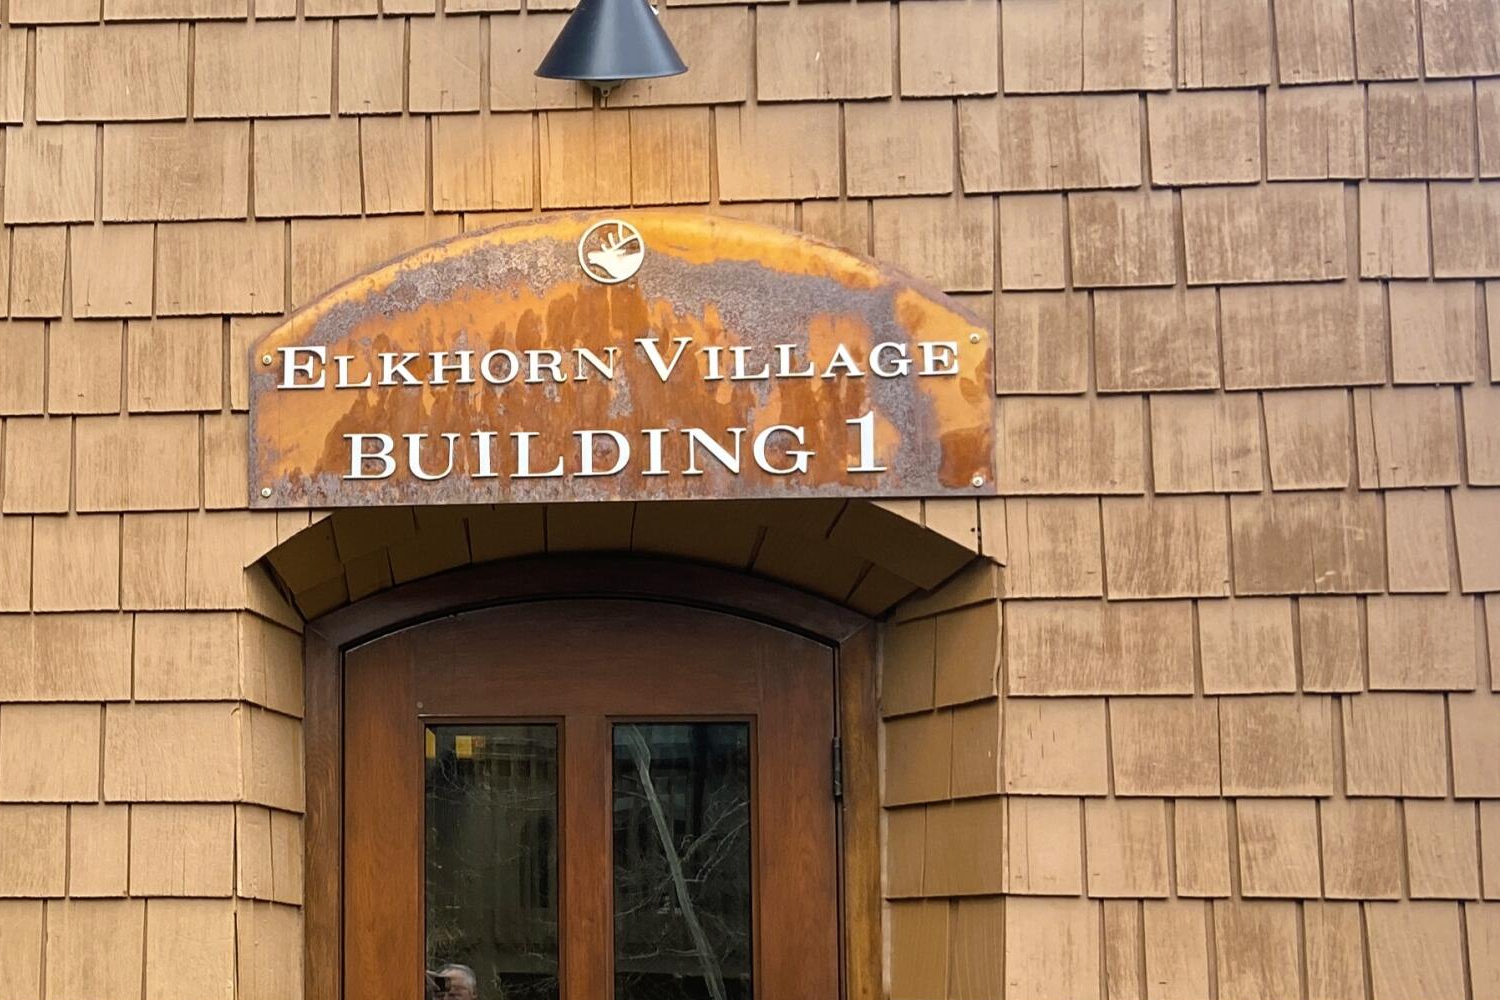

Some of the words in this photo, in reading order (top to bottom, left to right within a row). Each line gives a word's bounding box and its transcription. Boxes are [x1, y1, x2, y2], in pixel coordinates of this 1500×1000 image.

[277, 343, 618, 390] ELKHORN
[635, 337, 960, 384] VILLAGE
[343, 425, 816, 480] BUILDING
[845, 411, 888, 473] 1
